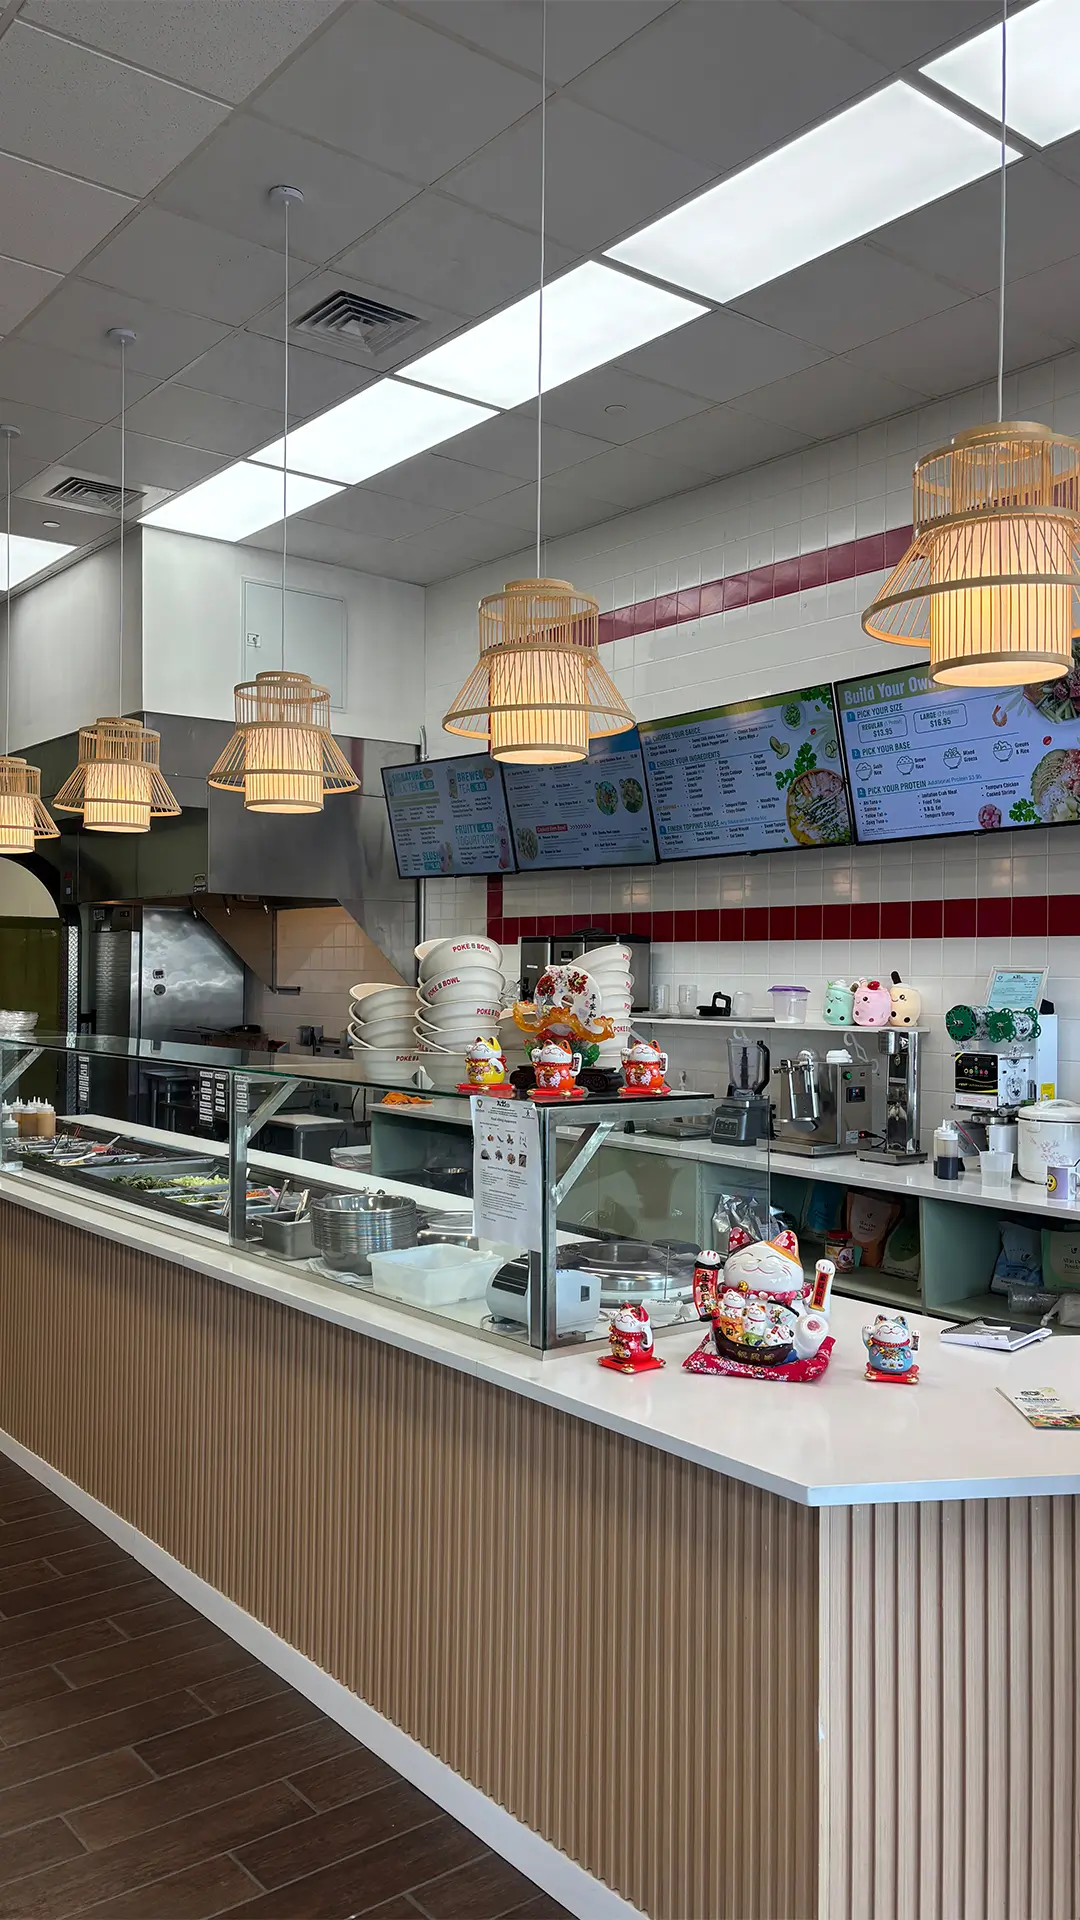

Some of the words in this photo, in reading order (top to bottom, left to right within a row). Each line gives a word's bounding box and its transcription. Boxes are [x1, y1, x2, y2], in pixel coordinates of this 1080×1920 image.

[844, 686, 875, 705] Build
[877, 681, 905, 698] Your
[857, 709, 871, 718] PICK
[872, 706, 889, 716] YOUR
[889, 703, 903, 713] SIZE
[920, 712, 937, 720] LARGE
[861, 721, 883, 731] REGULAR
[653, 732, 671, 742] CHOOSE
[671, 729, 685, 738] YOUR
[685, 726, 701, 736] SAUCE
[873, 727, 893, 738] $13.95
[862, 746, 876, 756] PICK
[877, 744, 893, 753] YOUR
[894, 741, 911, 751] BASE
[656, 757, 675, 767] CHOOSE
[675, 755, 689, 764] YOUR
[689, 750, 721, 760] INGREDIENTS
[868, 785, 881, 795] PICK
[883, 782, 899, 793] YOUR
[900, 780, 927, 791] PROTEIN
[455, 824, 477, 834] FRUITY
[683, 821, 703, 831] TOPPING
[703, 820, 720, 828] SAUCE
[477, 943, 492, 953] BOWL
[442, 977, 460, 987] BOWL
